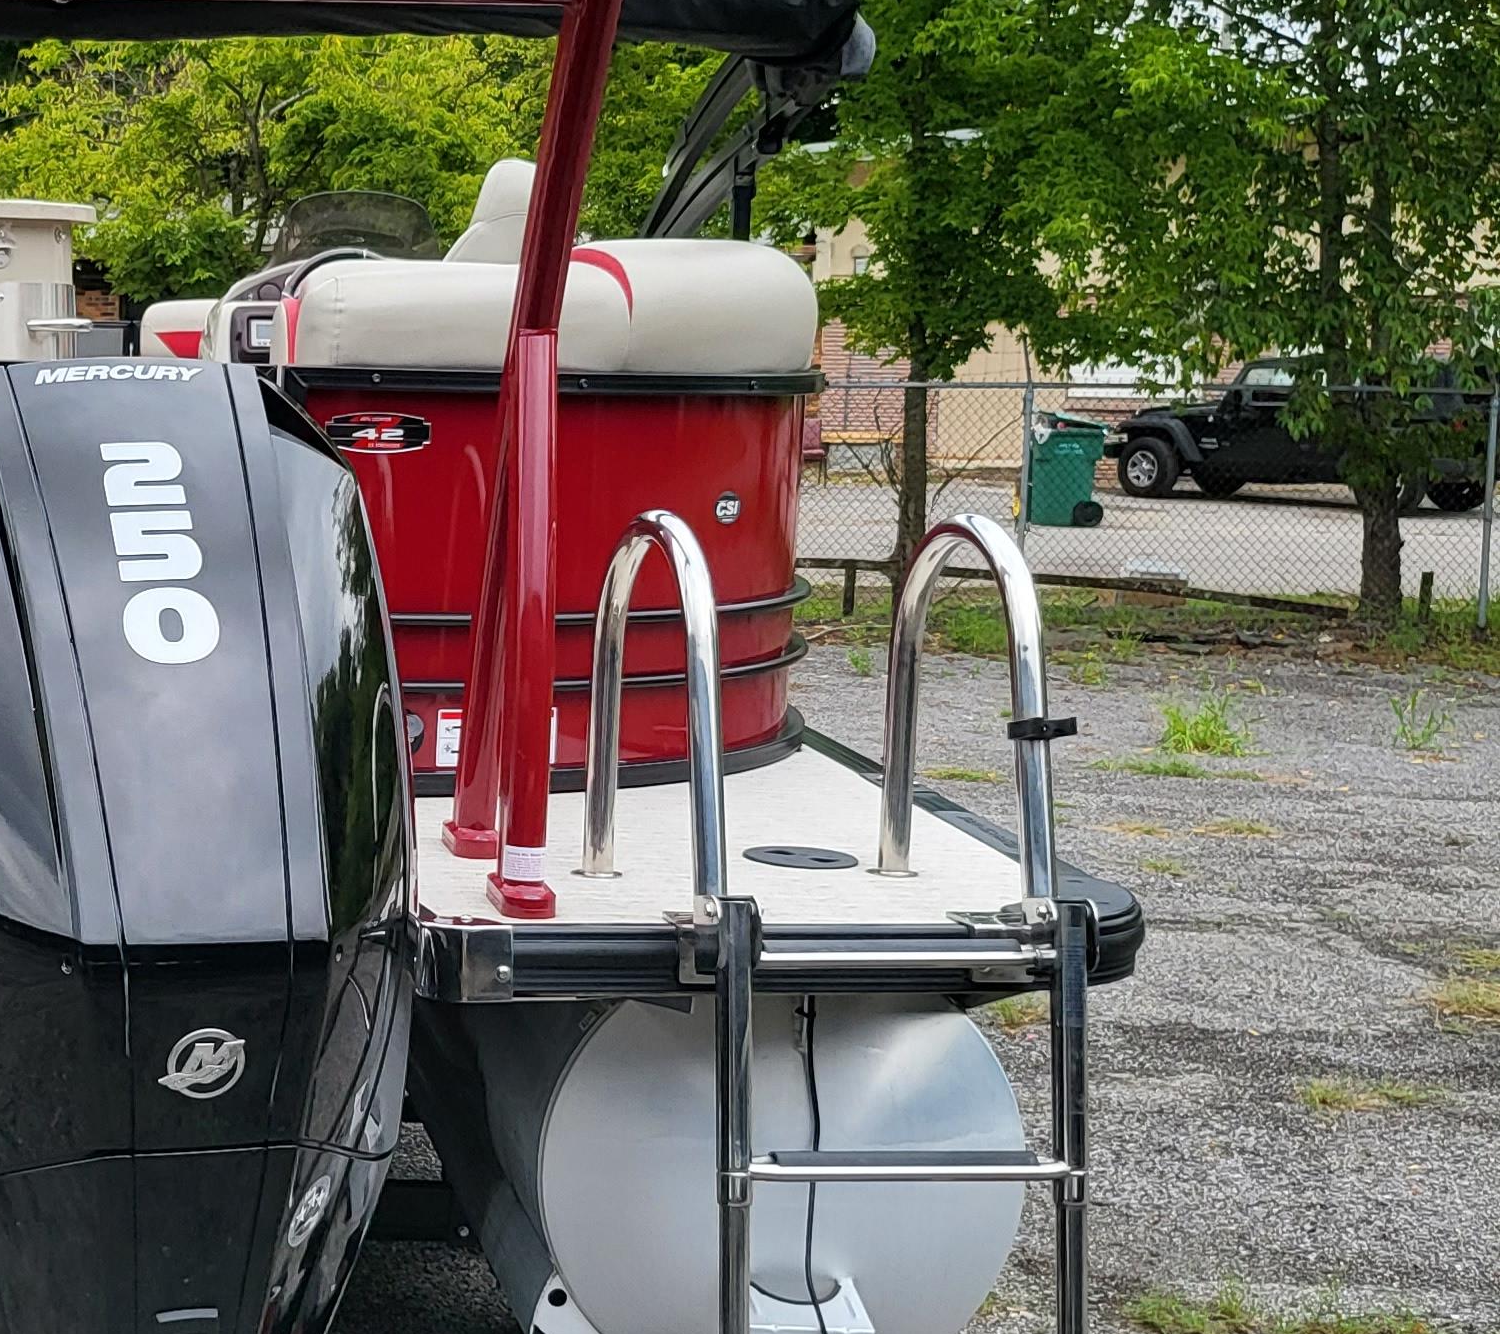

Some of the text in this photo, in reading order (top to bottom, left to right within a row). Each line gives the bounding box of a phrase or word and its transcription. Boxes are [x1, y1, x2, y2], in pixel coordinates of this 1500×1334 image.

[34, 365, 203, 386] MERCURY
[351, 428, 404, 440] 42
[99, 441, 220, 665] 250
